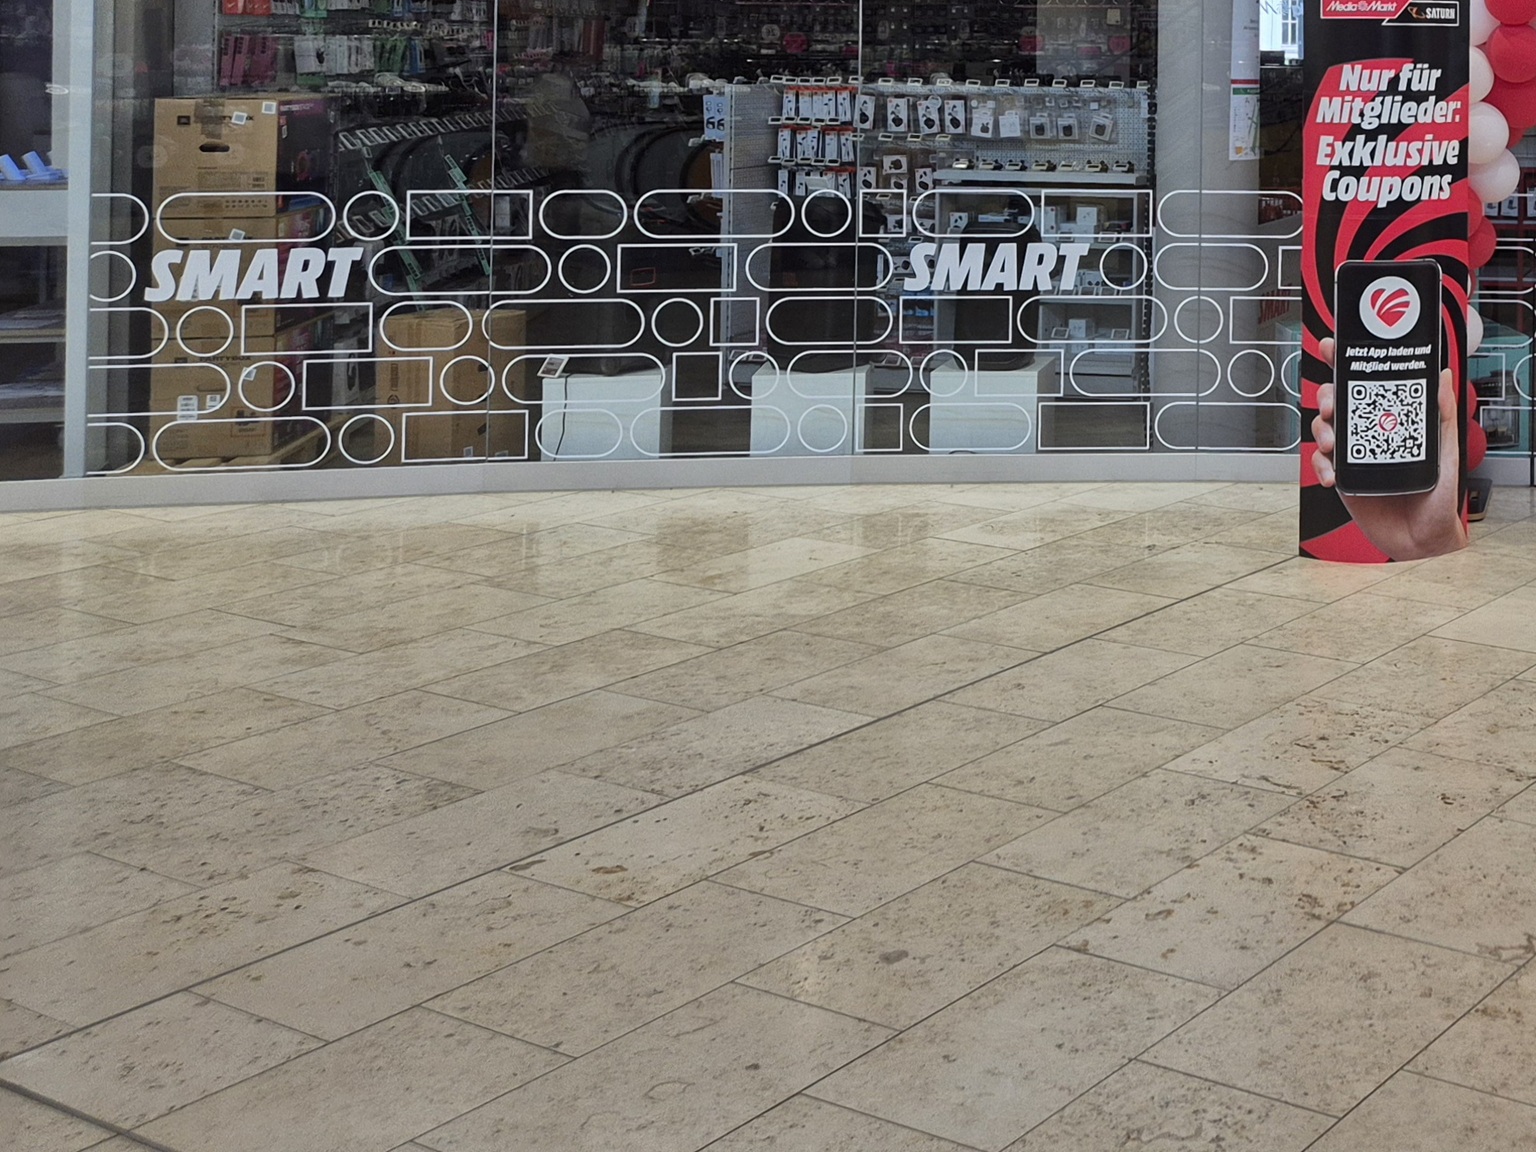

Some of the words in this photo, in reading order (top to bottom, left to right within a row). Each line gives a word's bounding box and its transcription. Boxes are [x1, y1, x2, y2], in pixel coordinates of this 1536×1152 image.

[1425, 7, 1456, 20] SATURN
[1338, 63, 1395, 92] Nur
[1398, 63, 1442, 92] für
[1315, 95, 1462, 130] Mitglieder:
[1315, 133, 1461, 167] Exklusive
[1322, 169, 1453, 208] Coupons
[145, 248, 366, 302] SMART
[902, 242, 1091, 291] SMART
[1345, 346, 1368, 358] Jetzt
[1368, 346, 1387, 359] App
[1387, 345, 1414, 357] laden
[1414, 344, 1432, 356] und
[1350, 360, 1390, 374] Mitglied
[1390, 359, 1427, 371] werden.
